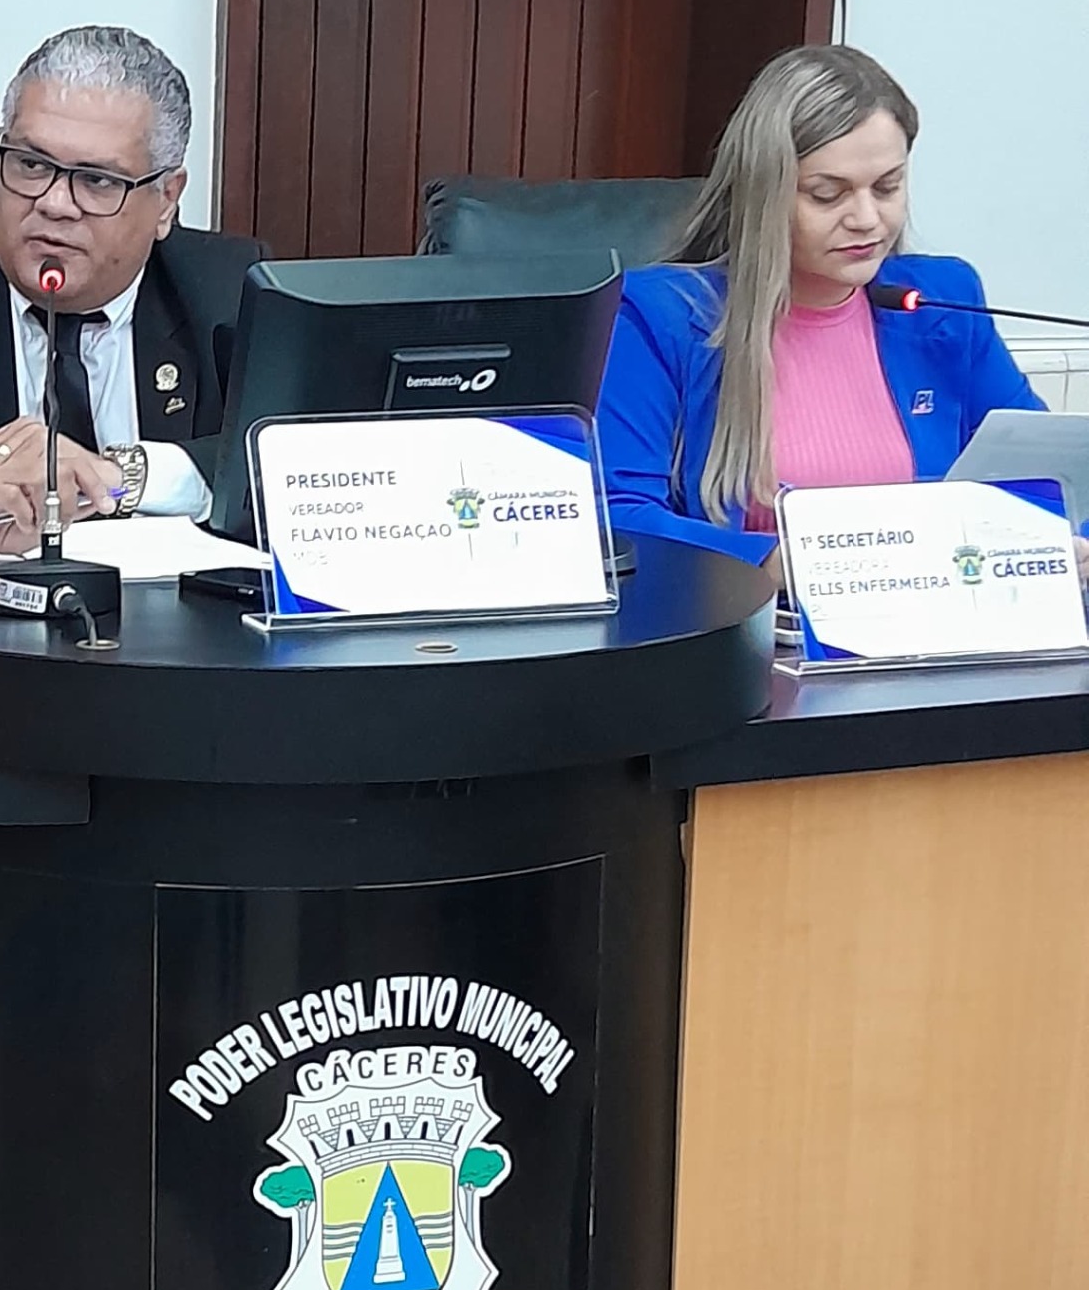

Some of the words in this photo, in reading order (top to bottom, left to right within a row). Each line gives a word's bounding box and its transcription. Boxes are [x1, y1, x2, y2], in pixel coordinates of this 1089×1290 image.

[407, 376, 462, 388] bematech
[286, 471, 397, 489] PRESIDENTE
[493, 501, 579, 522] CÁCERES
[817, 528, 914, 549] SECRETÁRIO
[993, 558, 1068, 578] CÁCERES
[809, 582, 844, 597] ELIS
[850, 576, 950, 593] ENFERMEIRA
[169, 1023, 270, 1121] PODER
[261, 975, 458, 1060] LEGISLATIVO
[456, 982, 576, 1096] MUNICIPAL
[305, 1050, 471, 1092] CÁCERES
